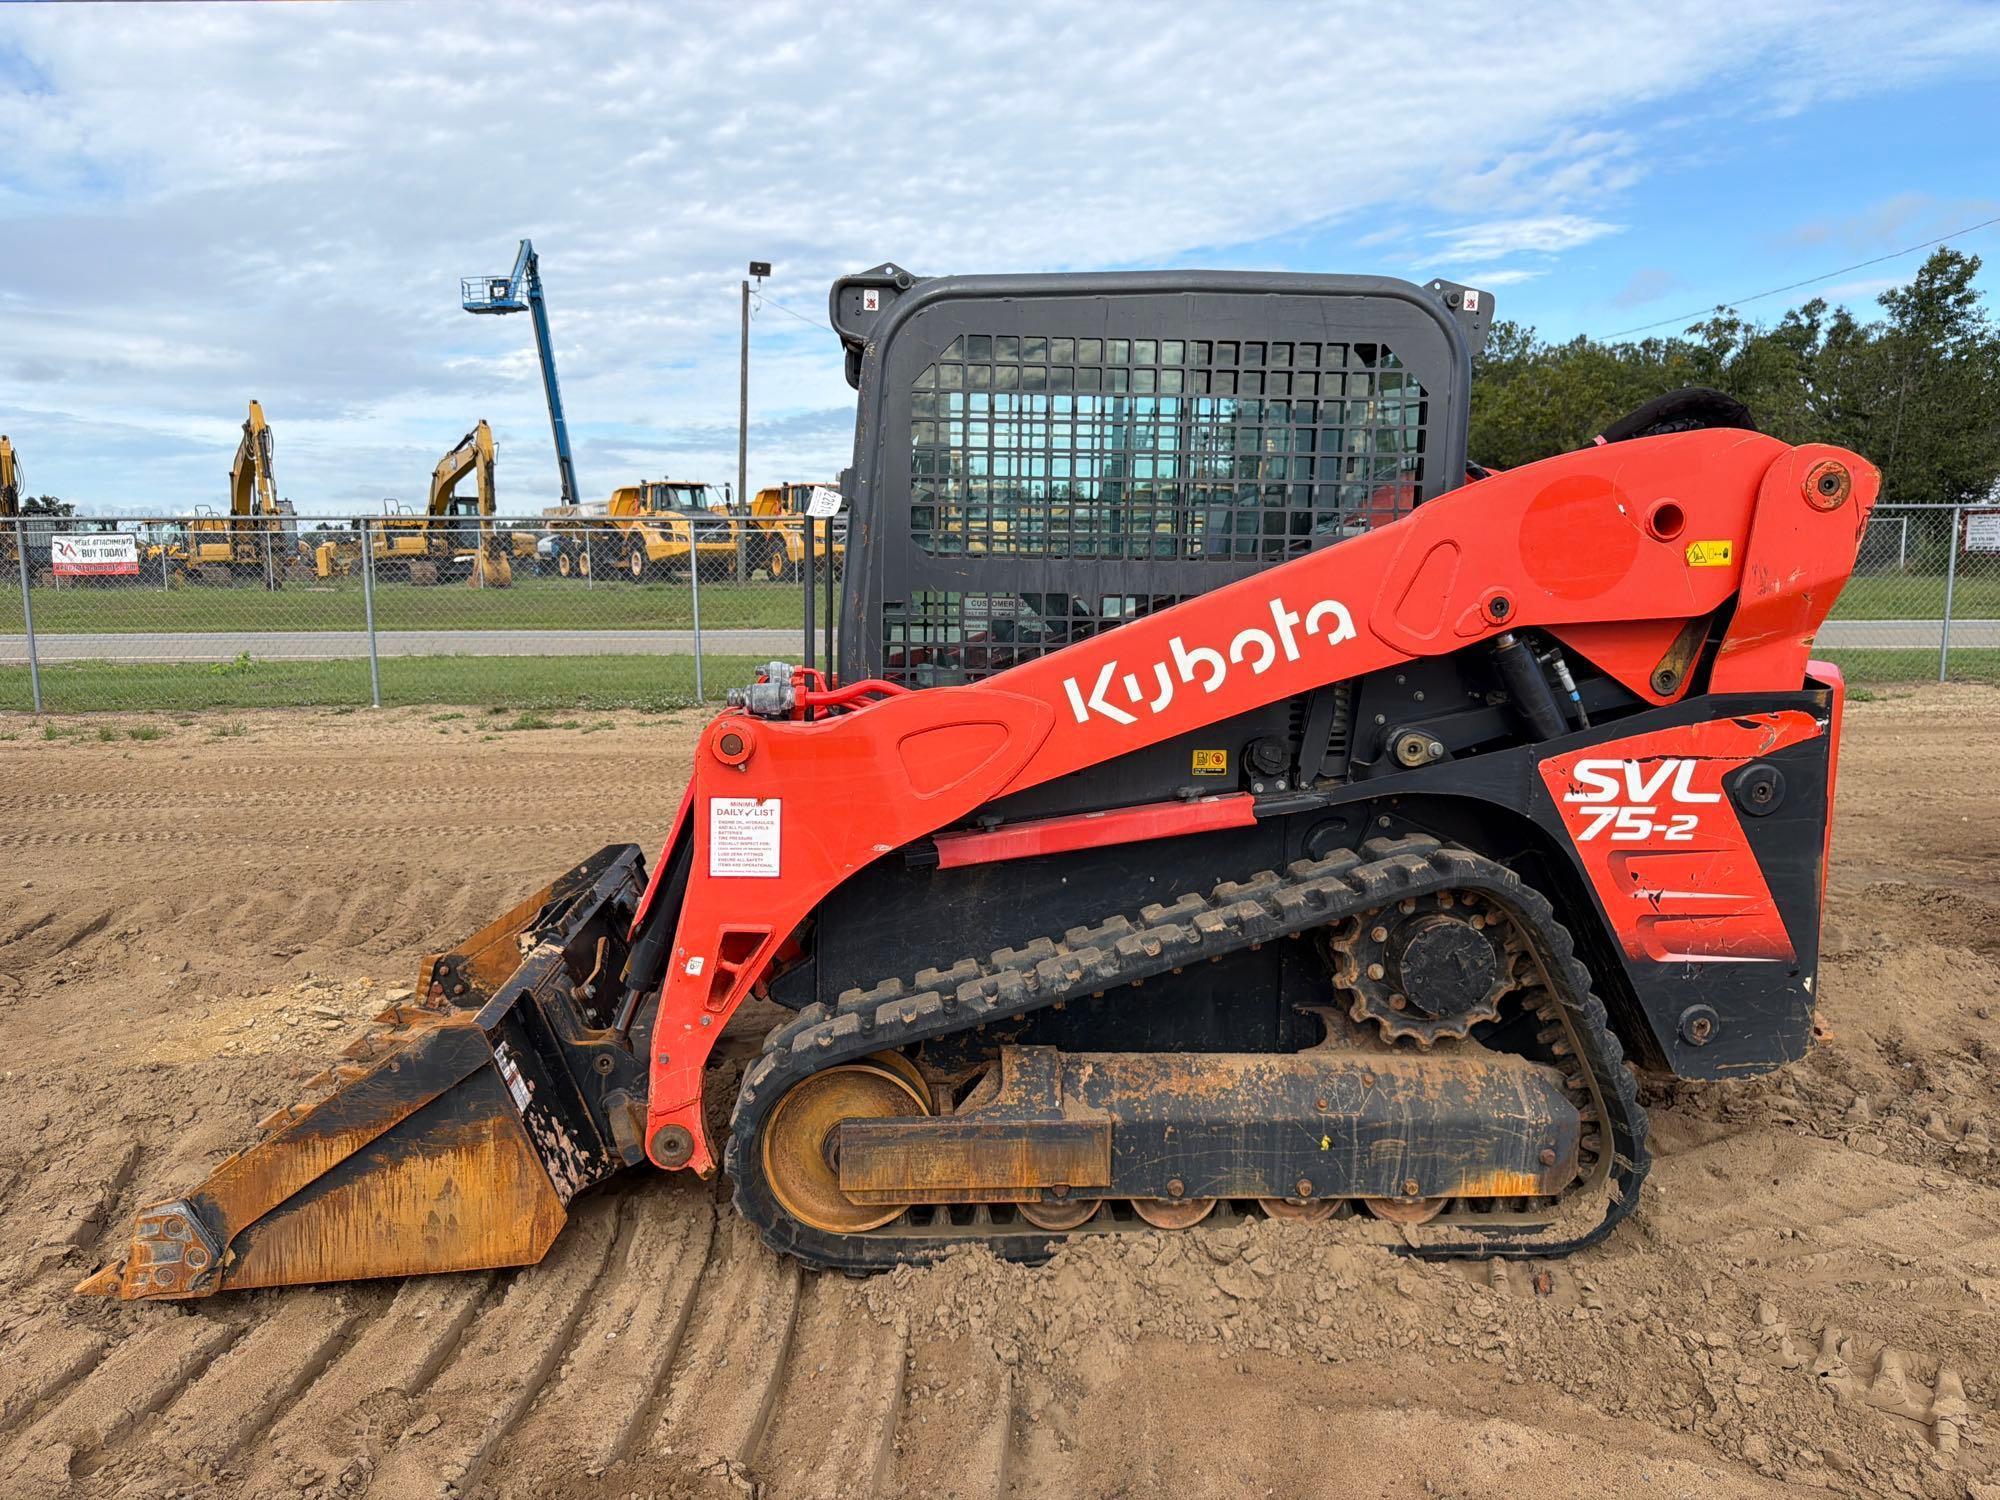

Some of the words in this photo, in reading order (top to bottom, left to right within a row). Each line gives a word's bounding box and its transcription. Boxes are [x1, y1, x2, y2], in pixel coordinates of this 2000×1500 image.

[81, 548, 97, 558] BUY
[100, 548, 128, 558] TODAY!
[971, 600, 1015, 608] CUSOMER
[1062, 597, 1357, 726] Kubota
[1563, 759, 1722, 803] SVL
[716, 808, 744, 816] DAILY
[754, 809, 775, 817] LIST
[1576, 806, 1699, 841] 75-2
